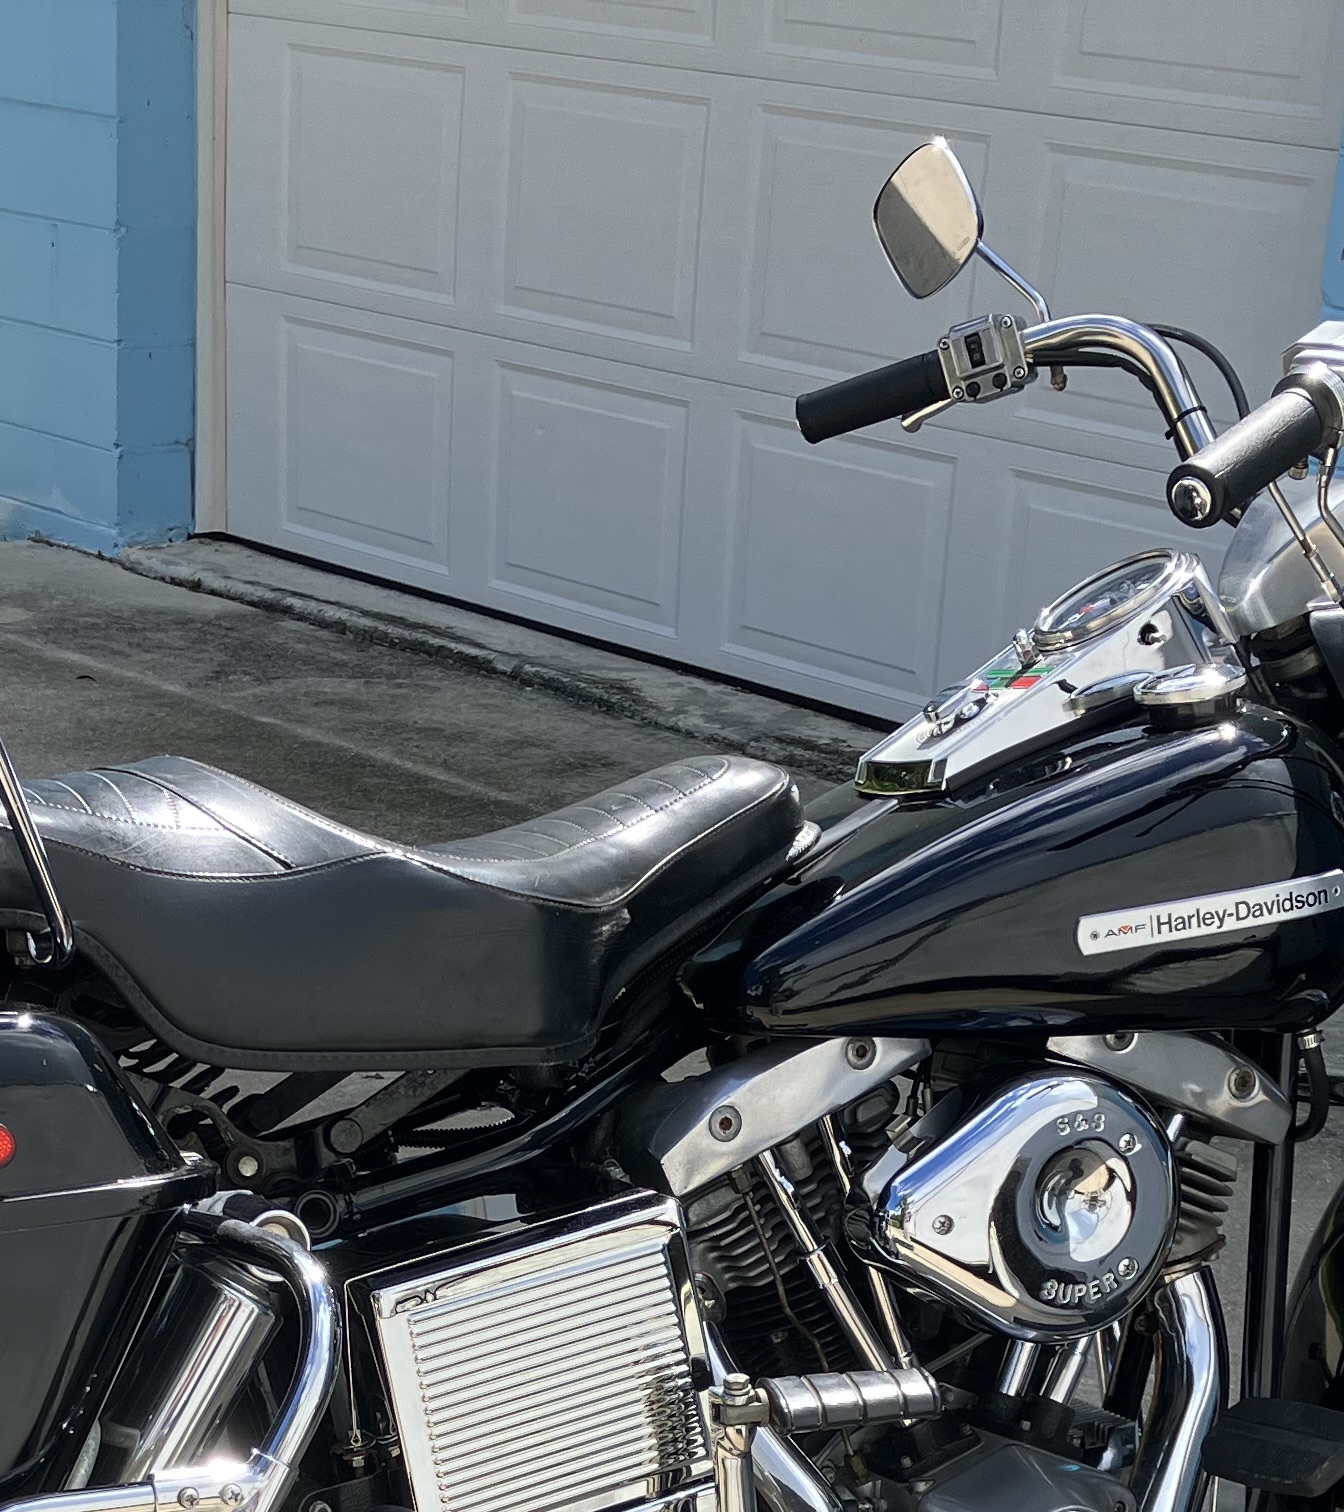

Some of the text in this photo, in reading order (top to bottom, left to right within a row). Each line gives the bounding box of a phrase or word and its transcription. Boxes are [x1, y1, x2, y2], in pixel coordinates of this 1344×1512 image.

[1104, 888, 1329, 939] AMF Harley-Davidson
[1040, 1272, 1118, 1305] SUPER
